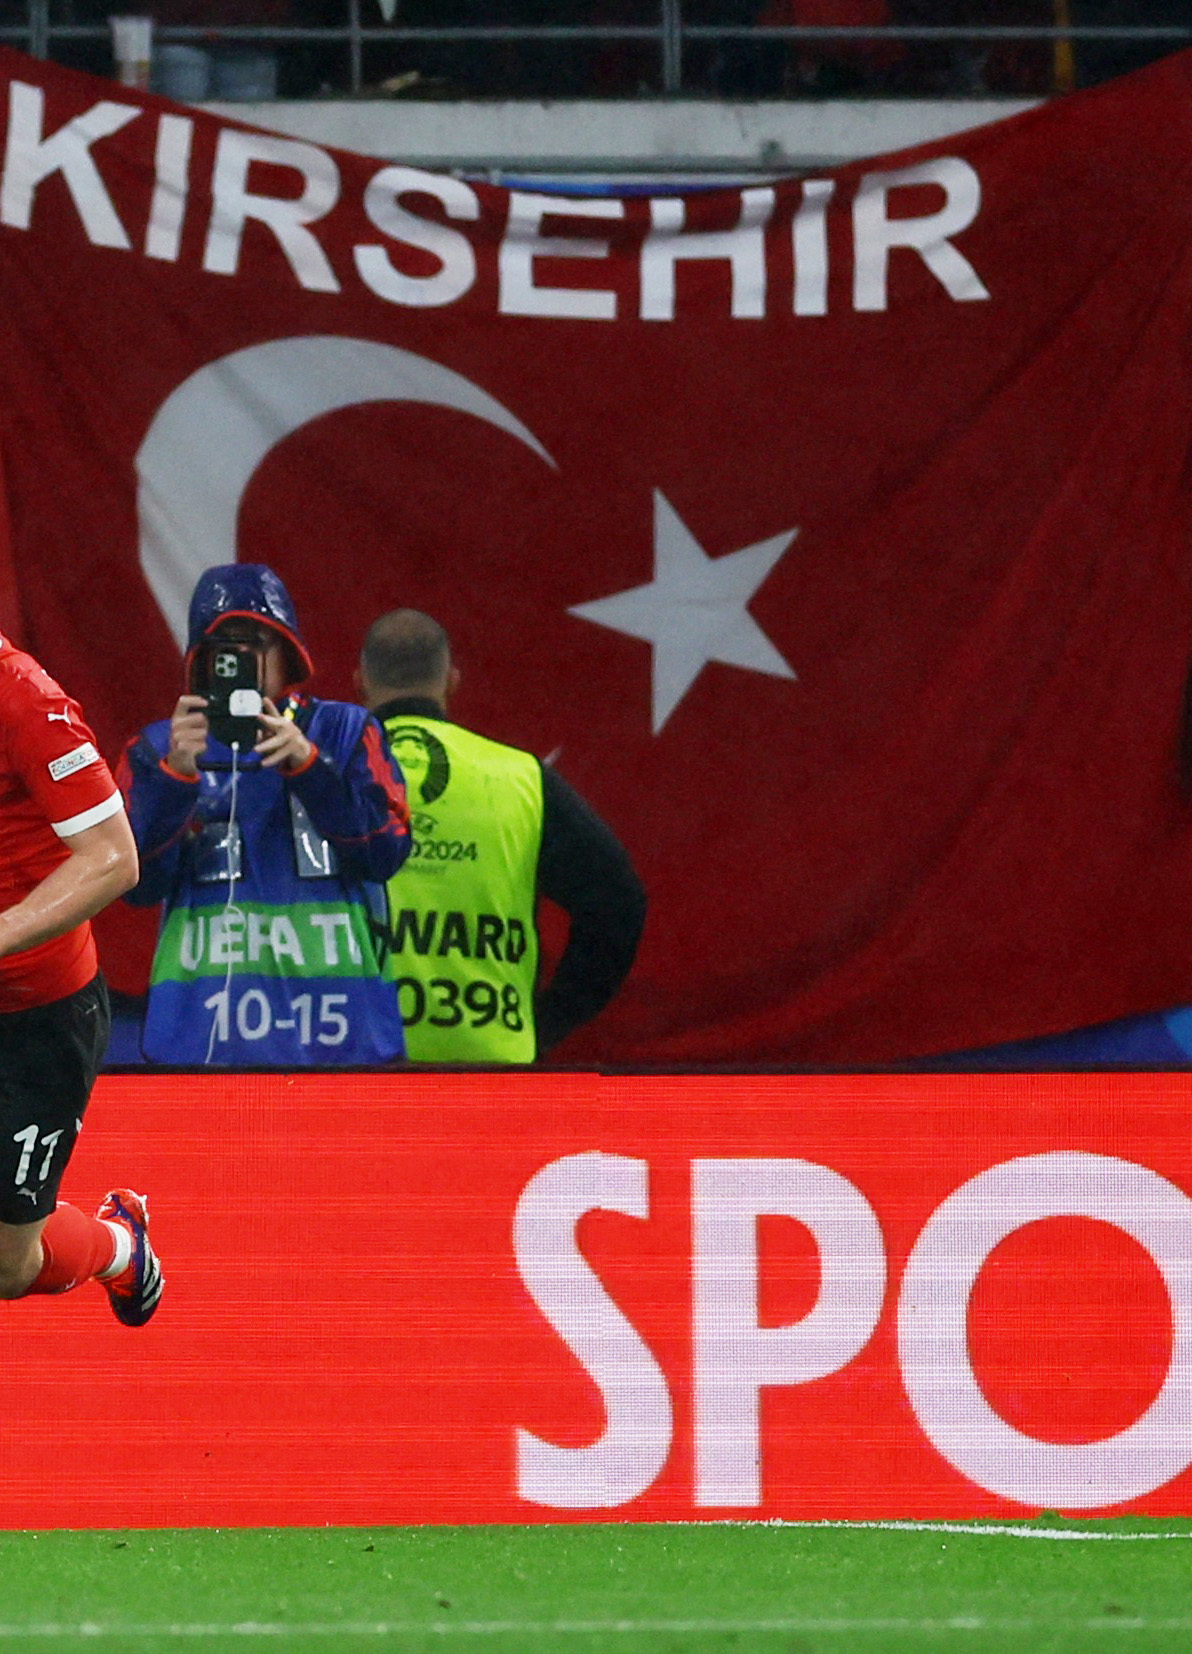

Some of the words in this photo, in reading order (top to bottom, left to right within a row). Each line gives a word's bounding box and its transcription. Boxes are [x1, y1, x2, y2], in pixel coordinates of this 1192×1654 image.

[180, 912, 306, 971] UEFA
[204, 988, 349, 1046] 10-15
[13, 1124, 65, 1186] 11
[512, 1149, 1192, 1510] SPO
